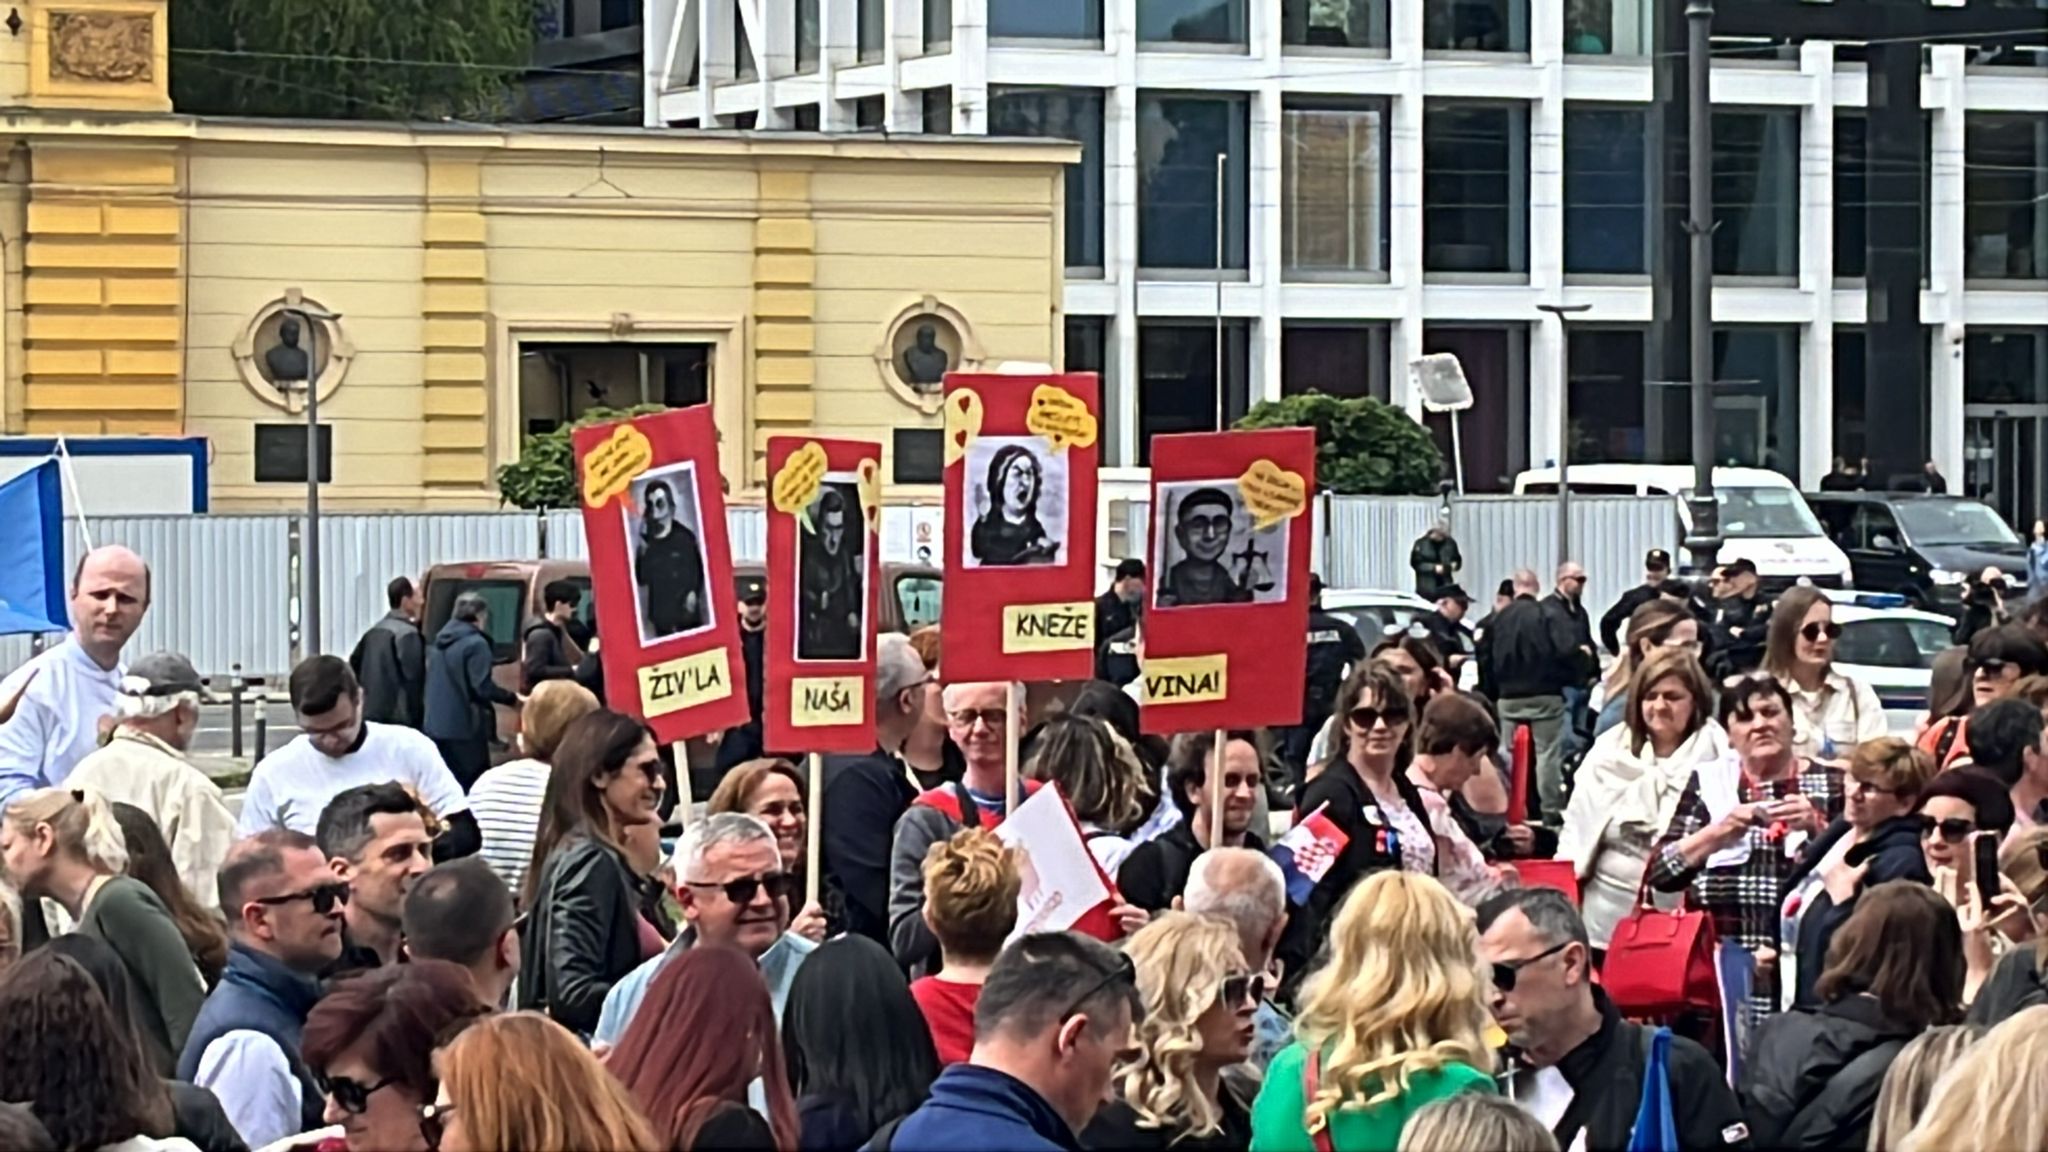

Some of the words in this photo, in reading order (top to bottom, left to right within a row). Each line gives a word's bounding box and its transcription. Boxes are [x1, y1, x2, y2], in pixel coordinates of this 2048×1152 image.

[1016, 606, 1088, 638] KNEŽE
[649, 666, 721, 700] ŽIV'LA
[805, 682, 851, 711] NAŠA
[1145, 671, 1219, 698] VINA!
